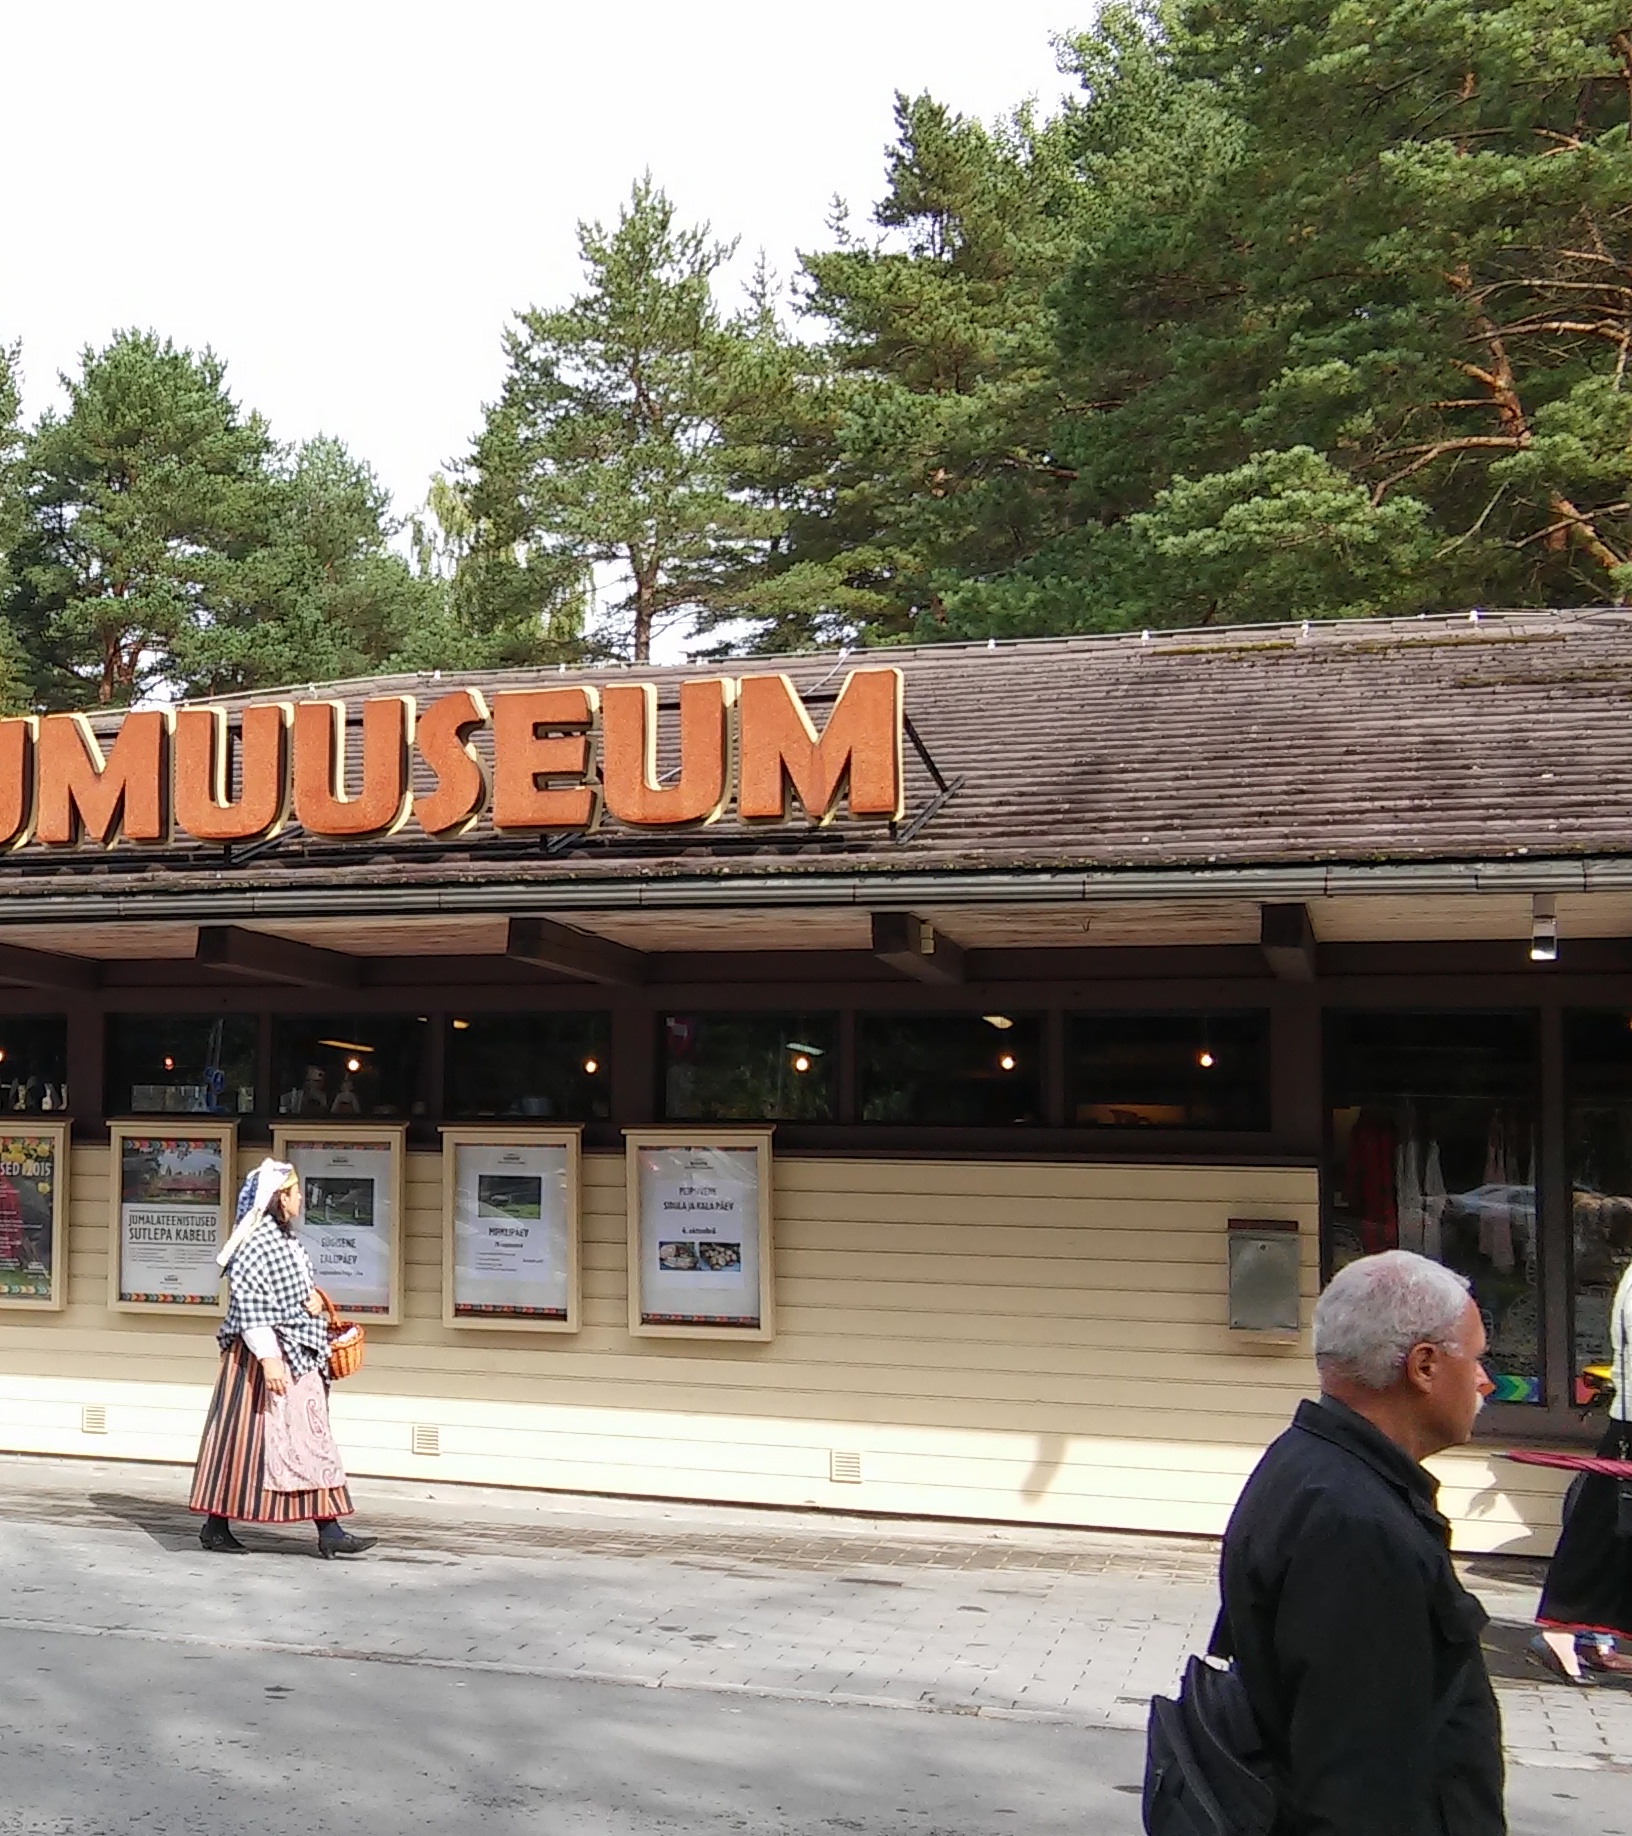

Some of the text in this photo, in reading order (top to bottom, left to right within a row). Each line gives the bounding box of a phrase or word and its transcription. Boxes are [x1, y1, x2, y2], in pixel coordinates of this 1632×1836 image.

[128, 1214, 217, 1227] JUMALATEENISTUSED
[129, 1227, 216, 1242] SUTLEPA KABELIS
